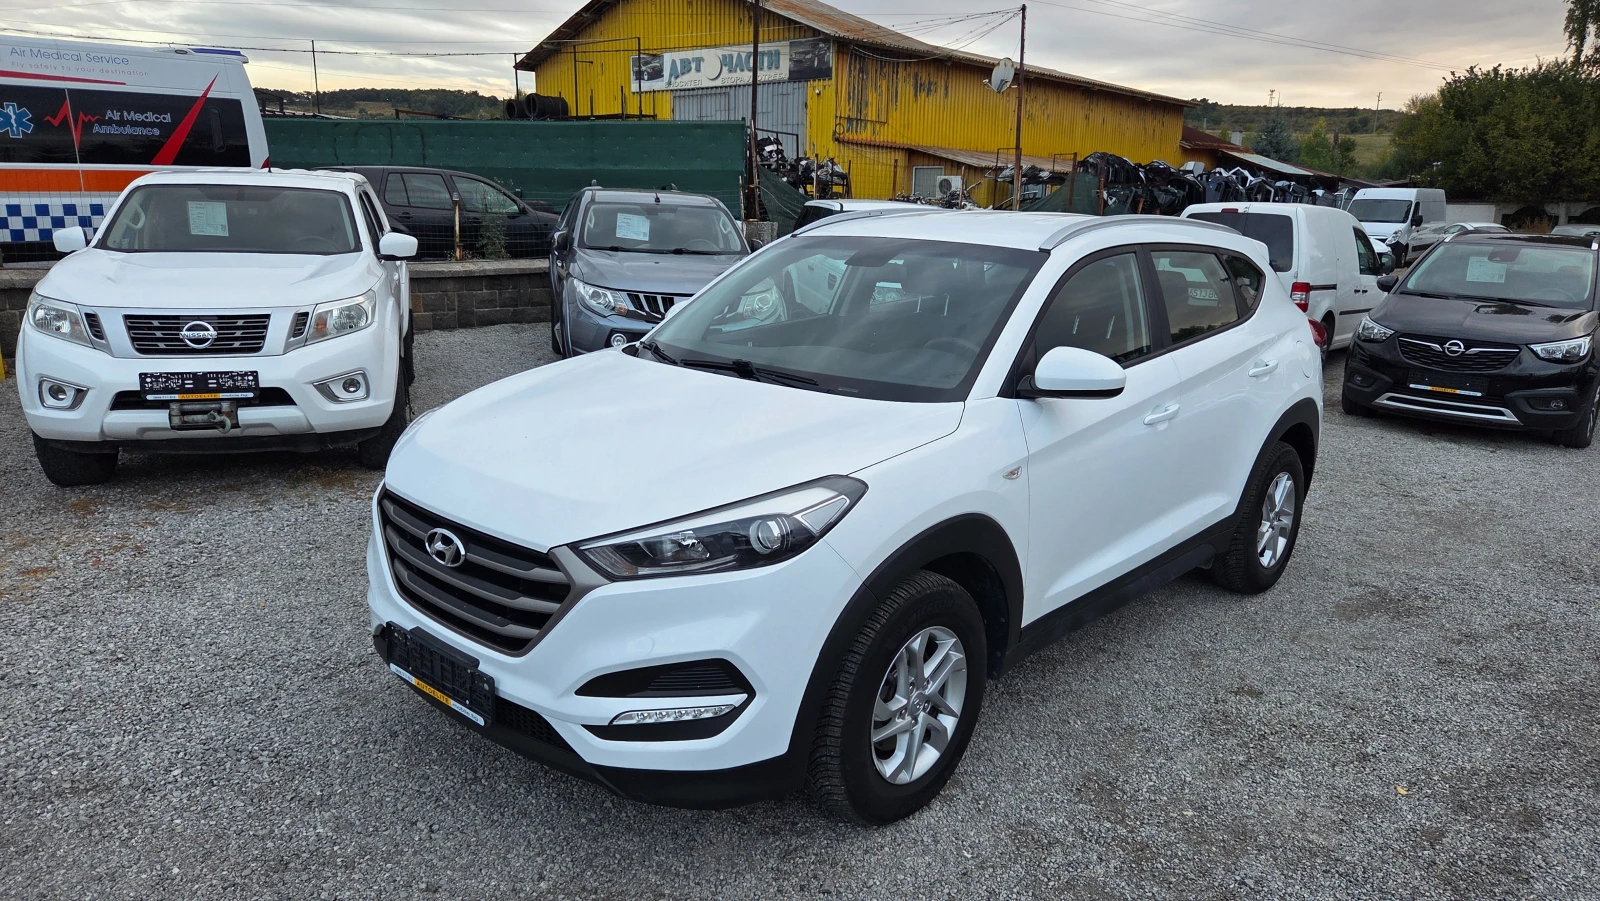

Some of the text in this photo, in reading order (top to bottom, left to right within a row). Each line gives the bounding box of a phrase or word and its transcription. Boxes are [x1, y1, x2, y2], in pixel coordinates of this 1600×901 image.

[10, 47, 129, 65] Air Medical Service
[29, 62, 58, 71] safely
[99, 68, 149, 77] destination
[105, 109, 172, 123] Air Medical
[92, 123, 161, 136] Ambulance
[416, 681, 450, 704] AUTOELITE
